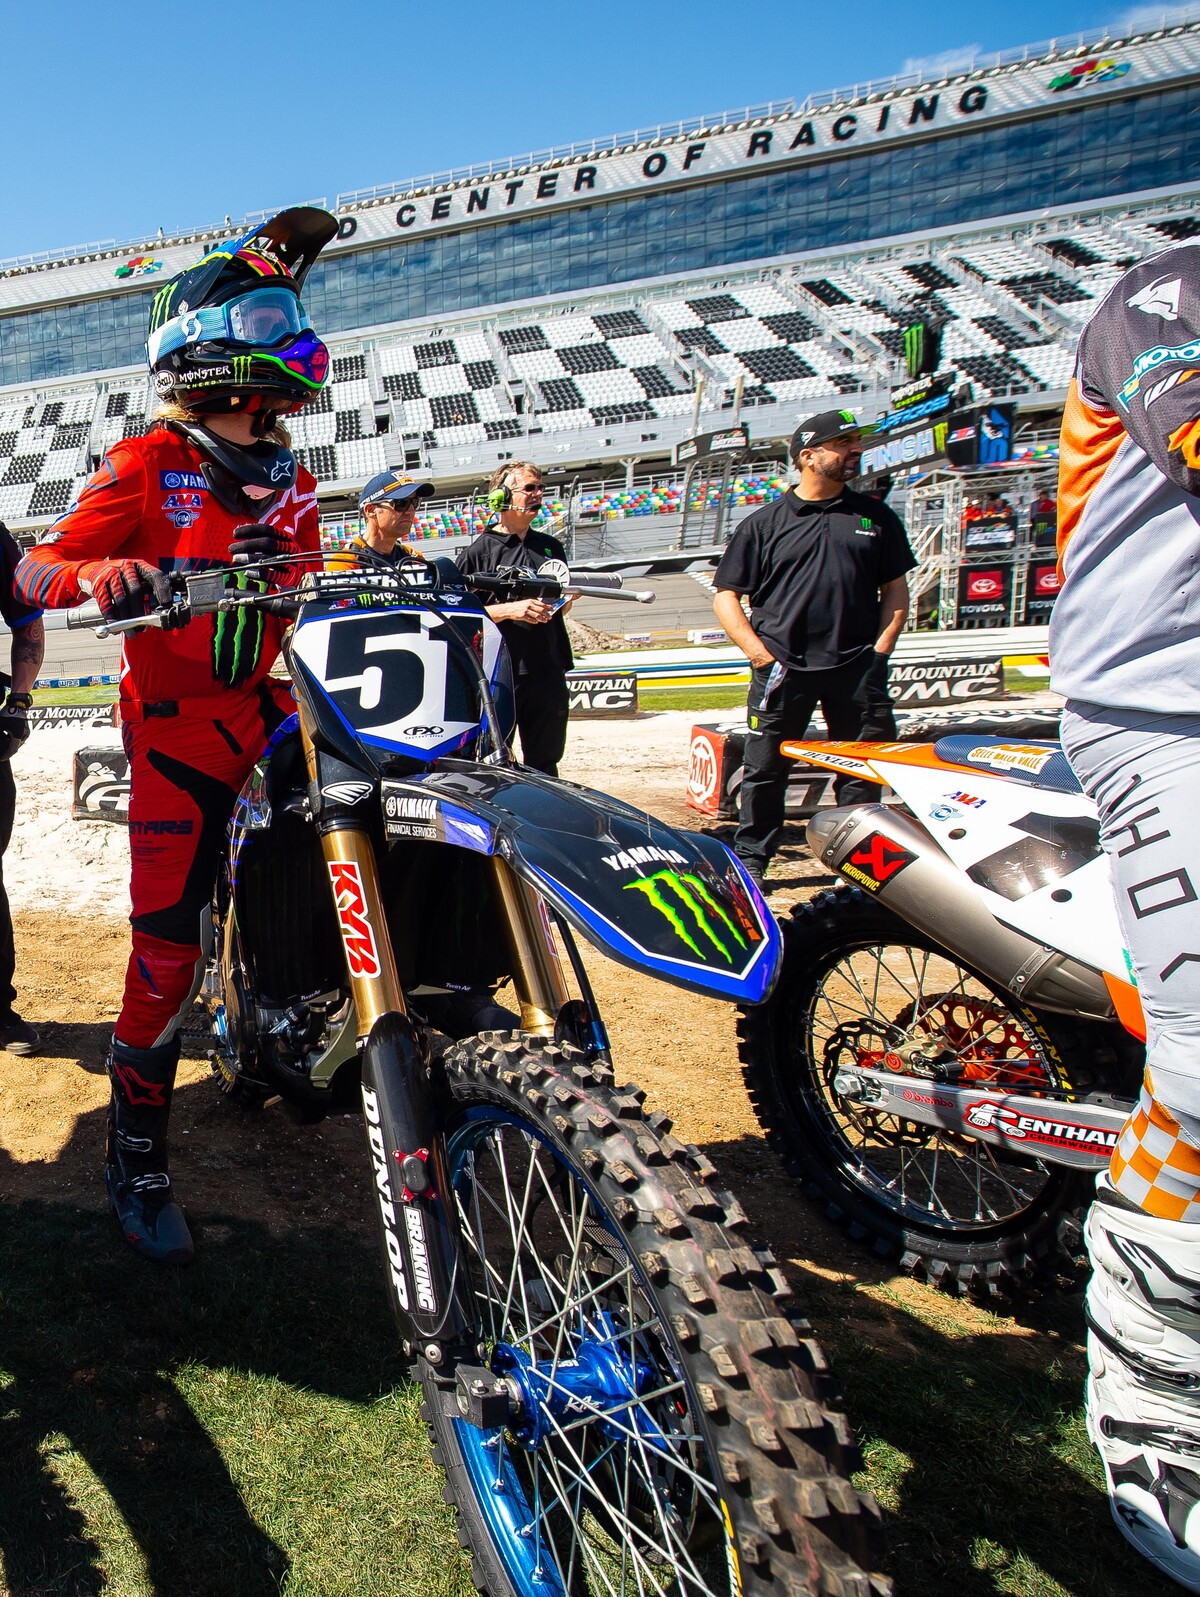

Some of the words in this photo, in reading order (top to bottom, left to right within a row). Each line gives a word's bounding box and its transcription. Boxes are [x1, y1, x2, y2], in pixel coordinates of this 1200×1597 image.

[396, 165, 598, 228] CENTER
[642, 143, 707, 178] OF
[746, 84, 990, 158] RACING
[179, 365, 232, 384] MONSTER
[861, 429, 933, 476] FINISH
[960, 604, 1005, 613] TOYOTA
[325, 613, 484, 730] 51
[887, 662, 1000, 682] MOUNTAIN
[43, 704, 113, 718] MOUNTAIN
[801, 752, 865, 768] DUNLOP
[970, 748, 994, 760] SELLE
[1017, 753, 1043, 770] VALLE
[396, 798, 437, 820] YAMAHA
[942, 790, 988, 809] AMA
[387, 823, 411, 835] FINANCIAL
[412, 827, 437, 839] SERVICES
[601, 846, 690, 872] YAMAHA
[327, 860, 382, 979] KYB
[914, 1092, 955, 1109] brembo
[1029, 1132, 1115, 1155] CHAINWHEEL
[360, 1081, 410, 1312] DUNLOP
[404, 1206, 436, 1313] BRAKING
